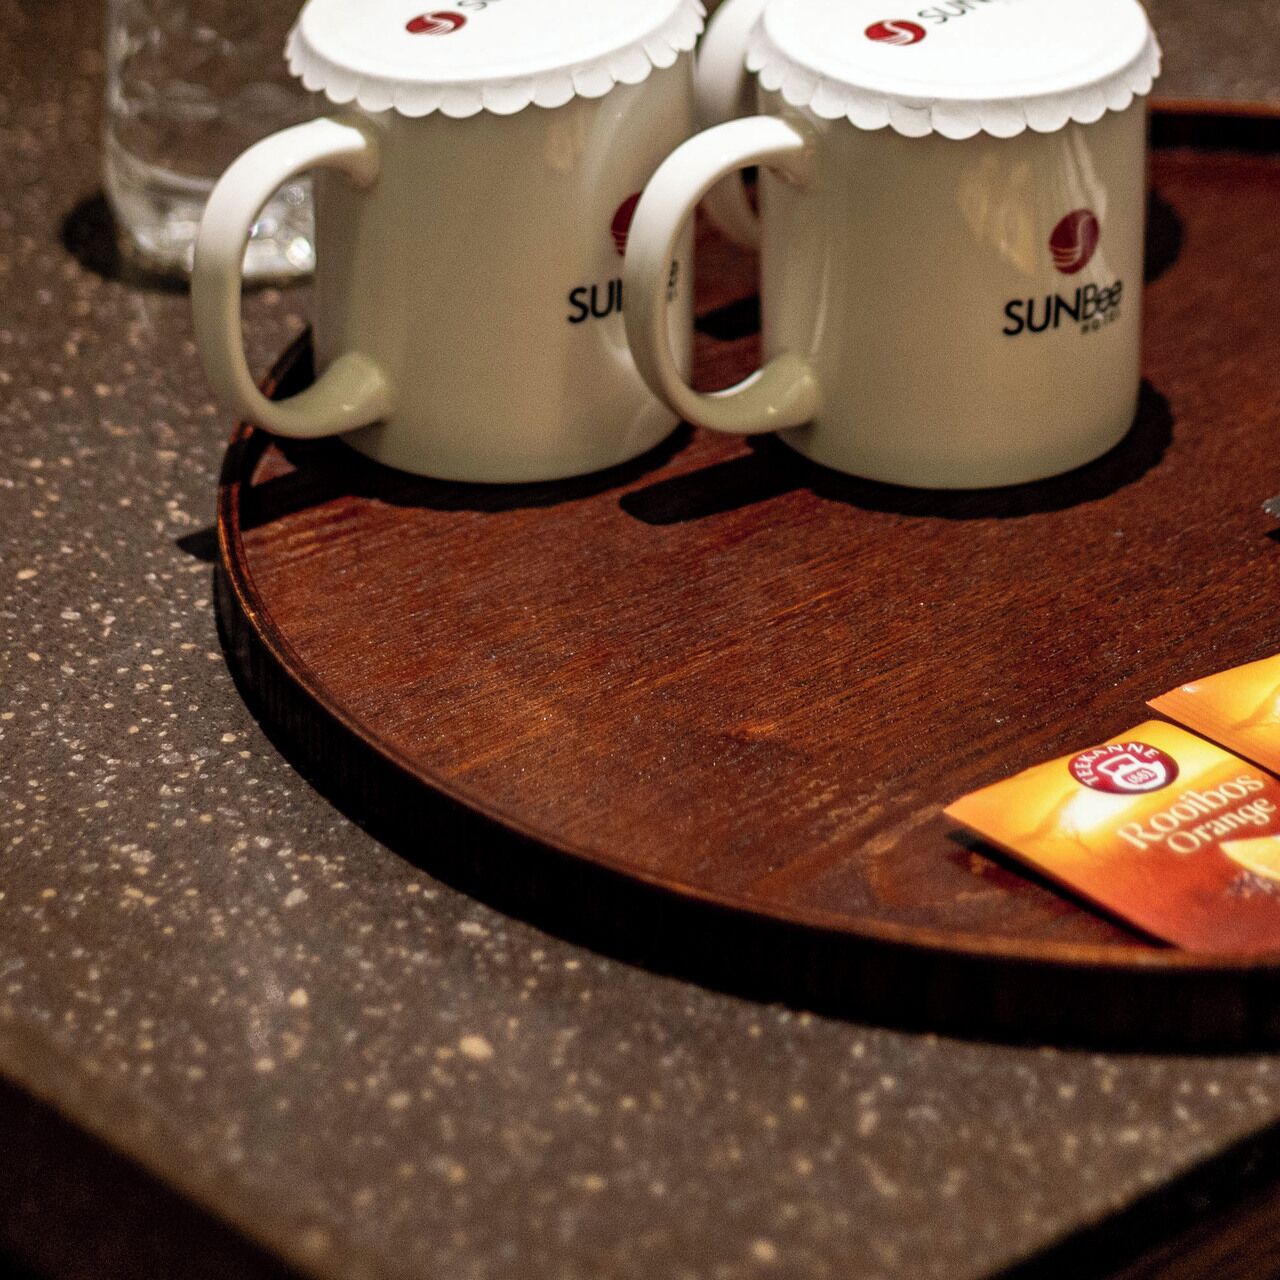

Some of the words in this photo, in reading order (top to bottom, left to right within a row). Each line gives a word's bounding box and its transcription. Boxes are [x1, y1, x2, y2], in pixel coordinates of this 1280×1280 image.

[1074, 742, 1160, 786] TEEKANNE
[1116, 774, 1265, 850] Rooibos
[1167, 798, 1278, 854] Orange
